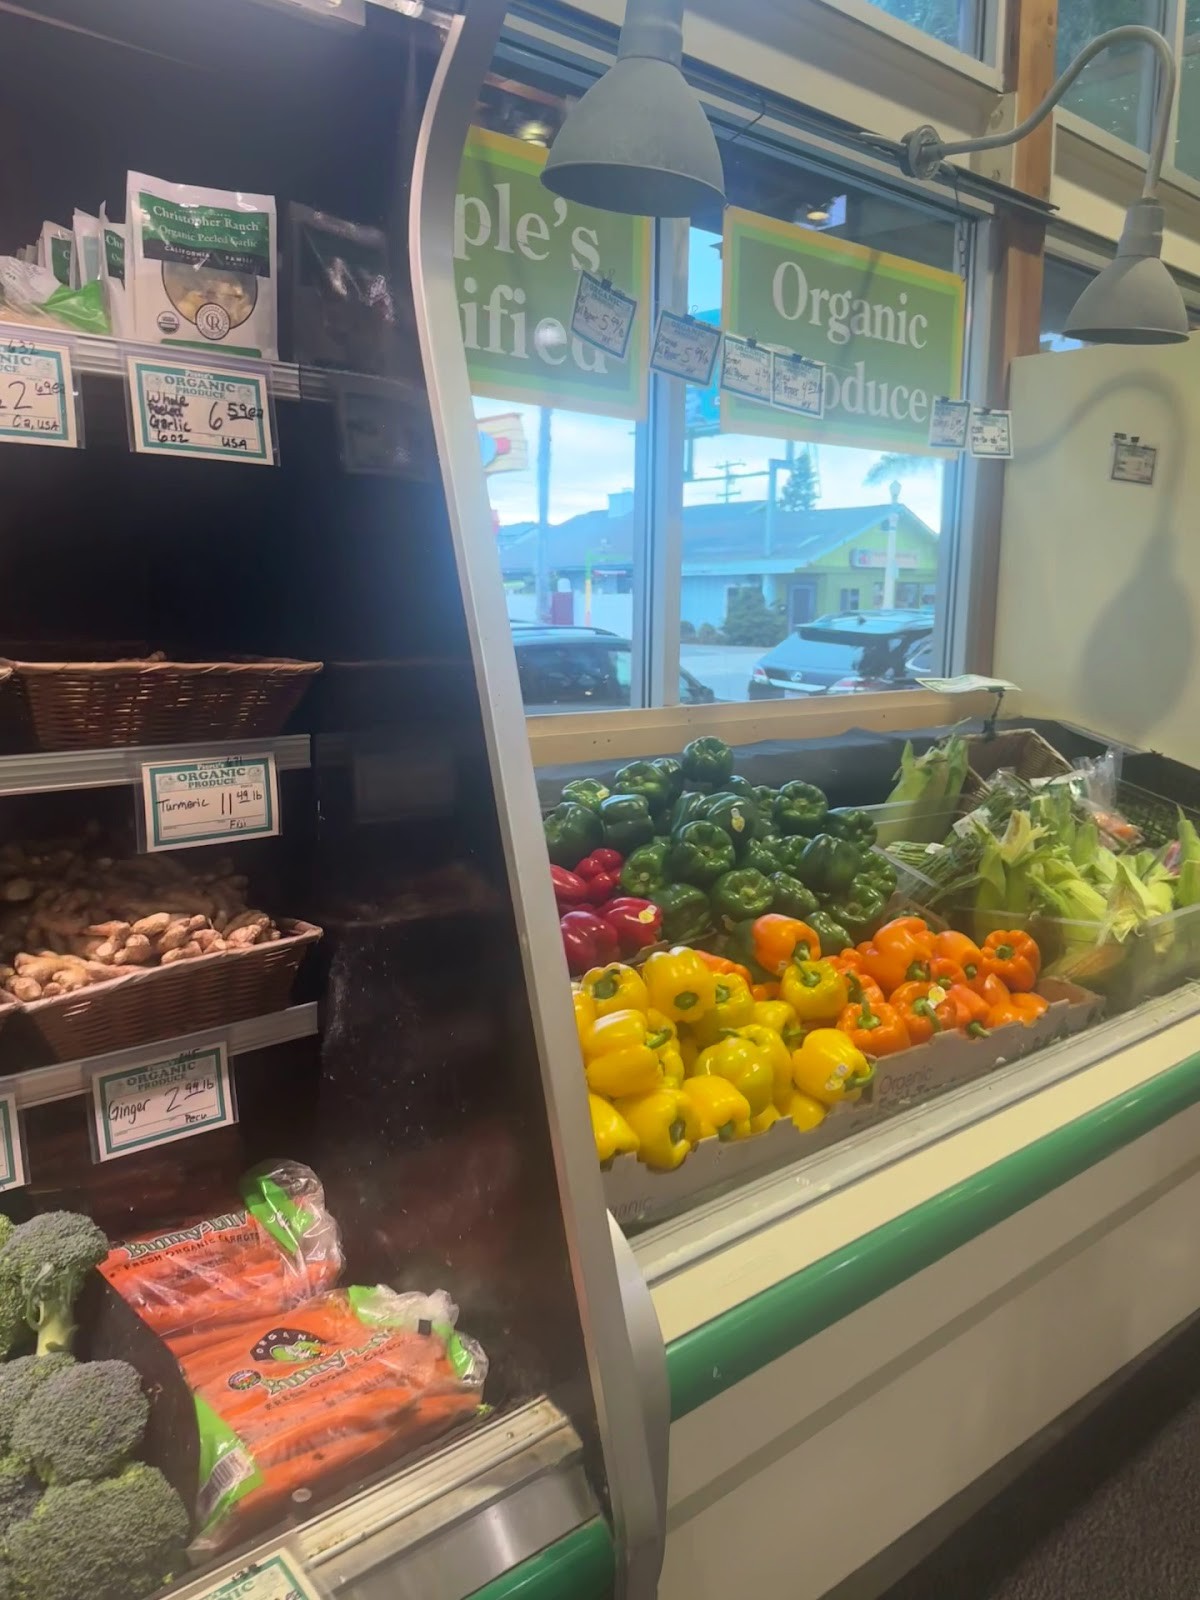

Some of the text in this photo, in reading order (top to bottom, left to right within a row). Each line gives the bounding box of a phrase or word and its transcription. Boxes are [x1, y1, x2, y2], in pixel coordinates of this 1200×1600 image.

[153, 206, 221, 228] Christopher
[224, 217, 260, 231] Ranch
[159, 225, 257, 247] Organic Peeled Garlic
[165, 246, 210, 257] CALIFORNIA
[772, 261, 928, 349] Organic
[164, 375, 236, 393] ORGANIC
[176, 387, 226, 399] PRODUCE
[147, 390, 189, 407] Whole
[37, 420, 60, 430] USA
[149, 415, 192, 432] Garlic
[209, 401, 223, 430] 6
[222, 437, 247, 450] USA
[177, 768, 246, 782] ORGANIC
[188, 778, 236, 788] PRODUCE
[156, 798, 210, 812] Turmeric
[221, 793, 232, 815] 11
[127, 1061, 196, 1086] ORGANIC
[138, 1073, 186, 1091] PRODUCE
[108, 1099, 151, 1125] Ginger
[165, 1086, 182, 1113] 2
[185, 1113, 208, 1124] Peru
[124, 1232, 259, 1270] FRESH ORGANIC CARROTS
